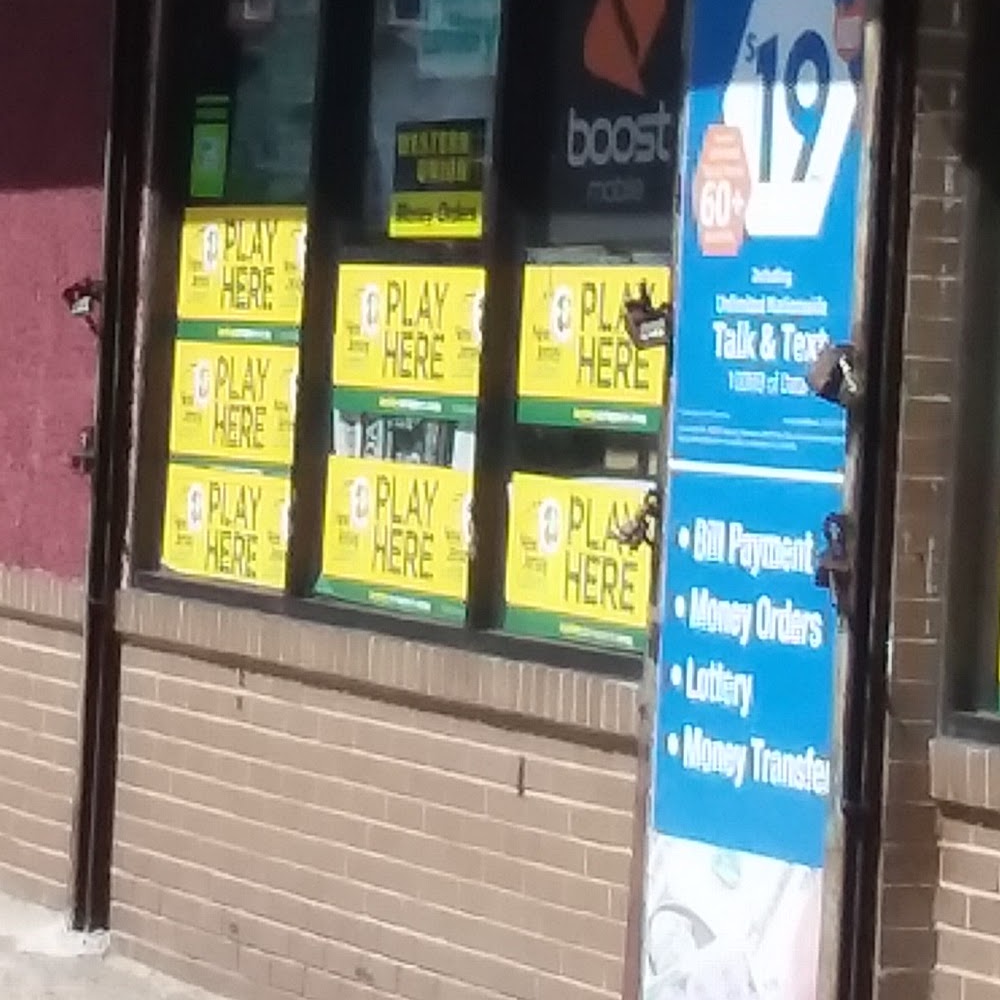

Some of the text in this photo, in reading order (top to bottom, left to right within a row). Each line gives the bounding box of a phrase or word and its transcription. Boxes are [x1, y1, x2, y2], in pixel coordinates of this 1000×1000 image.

[567, 99, 672, 168] boost
[222, 216, 278, 262] PLAY
[219, 265, 276, 311] HERE
[385, 279, 450, 329] PLAY
[381, 330, 445, 380] HERE
[575, 335, 650, 390] HERE
[712, 320, 757, 361] Talk
[759, 322, 777, 362] &
[214, 355, 271, 403] PLAY
[210, 401, 268, 449] HERE
[208, 480, 262, 531] PLAY
[375, 473, 440, 528] PLAY
[204, 528, 259, 579] HERE
[371, 524, 434, 579] HERE
[693, 516, 814, 578] Bill Payment
[564, 549, 639, 615] HERE
[689, 586, 753, 646] Money
[755, 593, 824, 649] Orders
[685, 655, 754, 718] Lottery
[682, 723, 748, 789] Money
